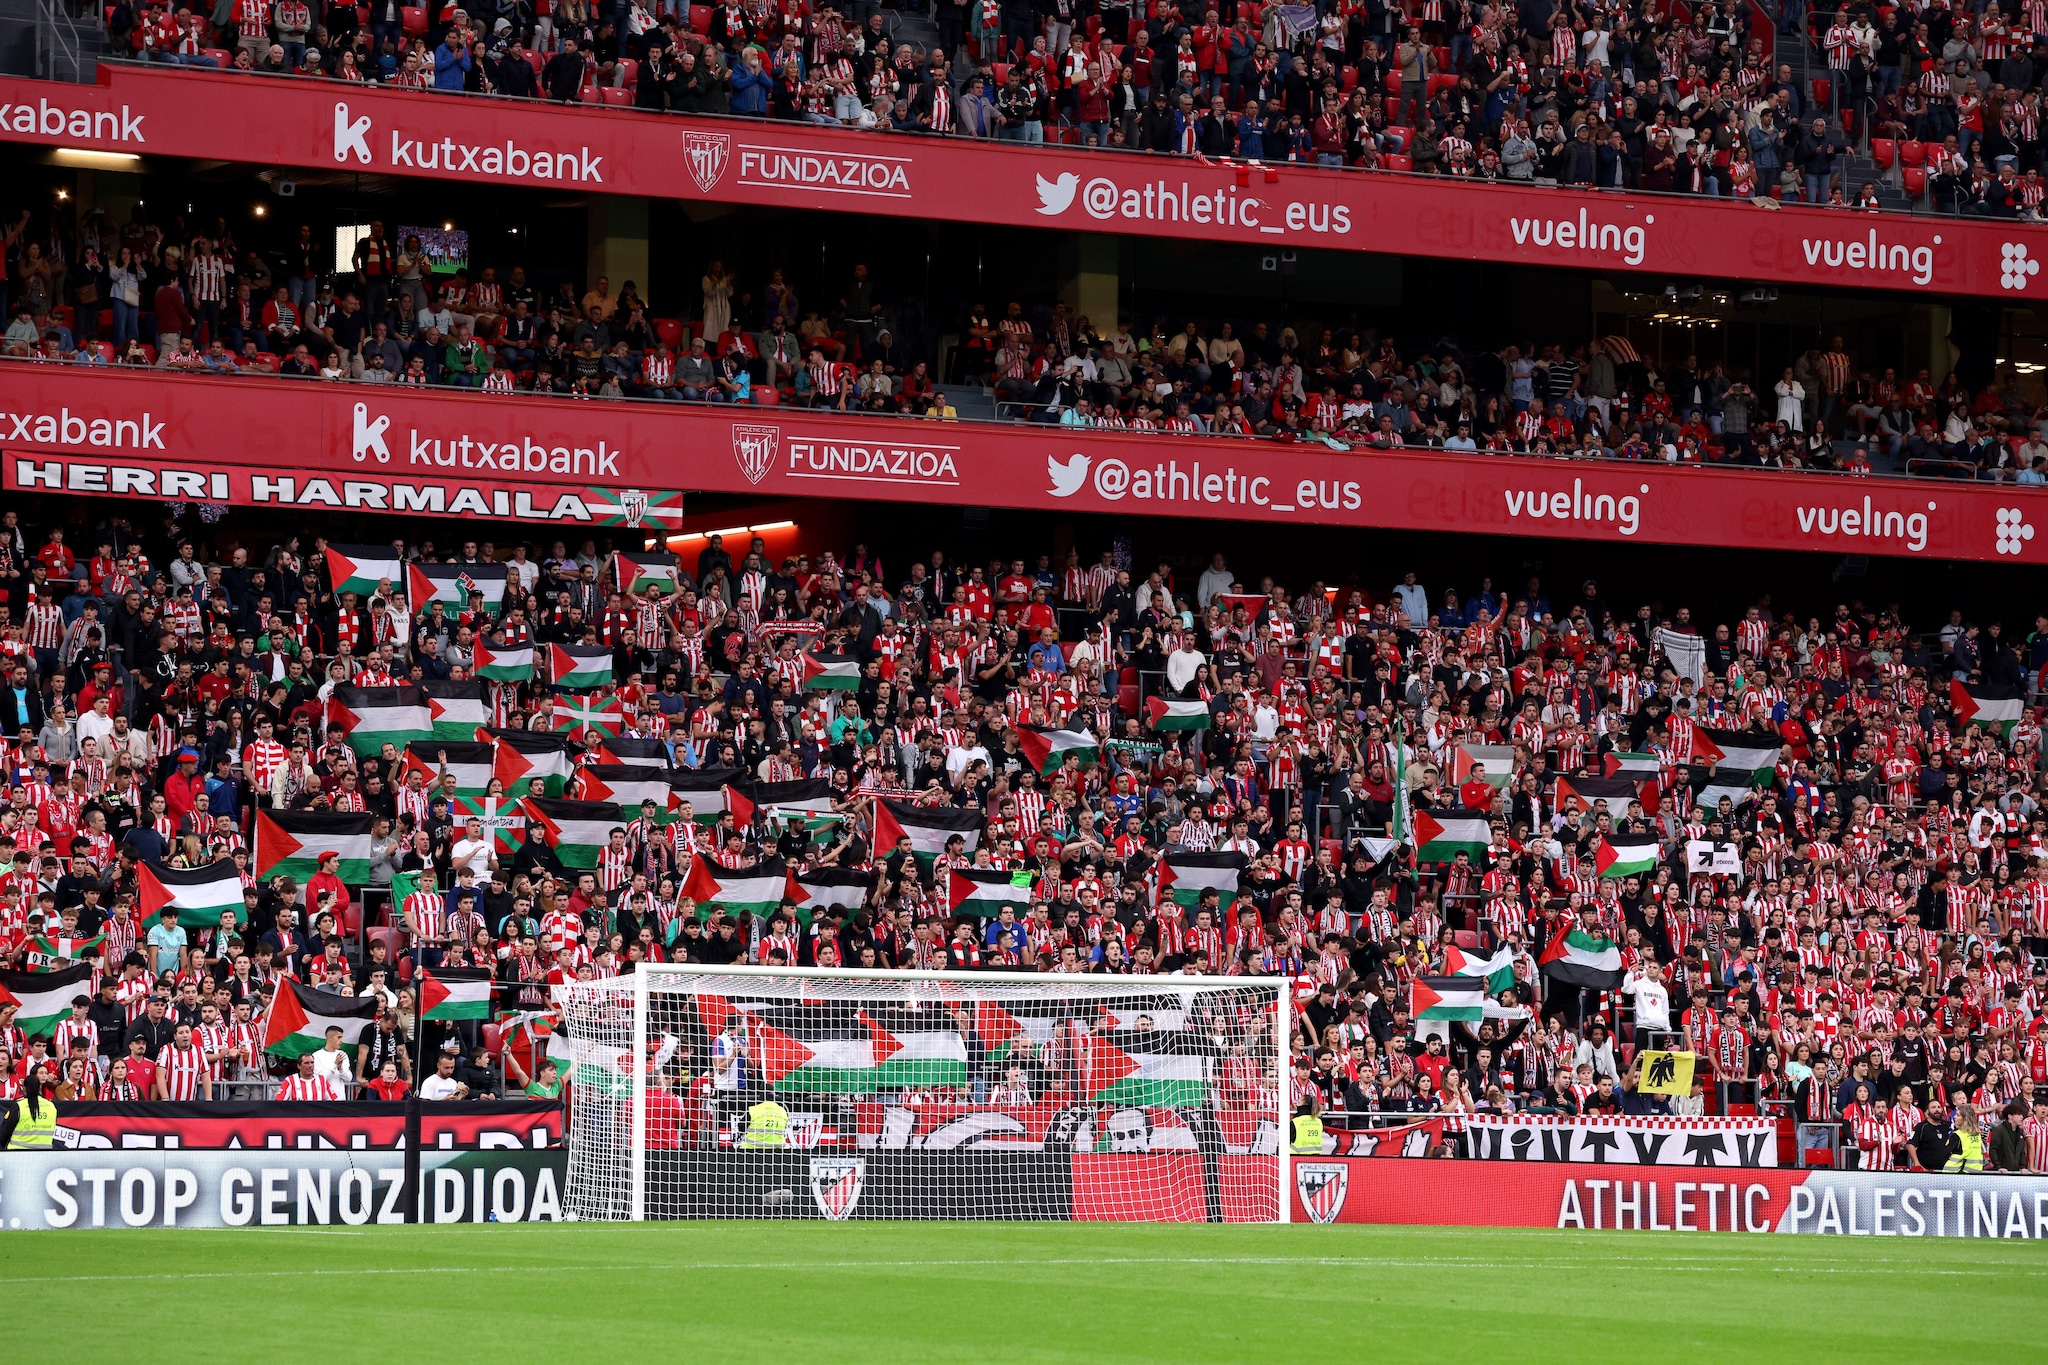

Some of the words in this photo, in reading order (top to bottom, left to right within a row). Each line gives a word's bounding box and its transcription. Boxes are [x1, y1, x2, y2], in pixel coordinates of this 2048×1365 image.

[391, 129, 603, 183] kutxabank
[686, 133, 711, 141] ATHLETIC
[696, 174, 717, 189] BILBAO
[741, 152, 910, 190] FUNDAZIOA
[1082, 177, 1351, 234] @athletic_eus
[1510, 206, 1655, 265] vueling
[1802, 229, 1942, 285] vueling
[410, 429, 620, 477] kutxabank
[745, 465, 766, 482] BILBAO
[790, 443, 958, 478] FUNDAZIOA
[16, 460, 229, 500] HERRI
[251, 475, 593, 521] HARMAILA
[1093, 458, 1362, 512] @athletic_eus
[1504, 477, 1649, 535] vueling
[1796, 495, 1937, 552] vueling
[462, 814, 515, 828] iendentzia
[54, 1128, 76, 1142] LUB
[1307, 1129, 1319, 1138] 299
[44, 1167, 199, 1229] STOP
[1557, 1178, 1771, 1234] ATHLETIC
